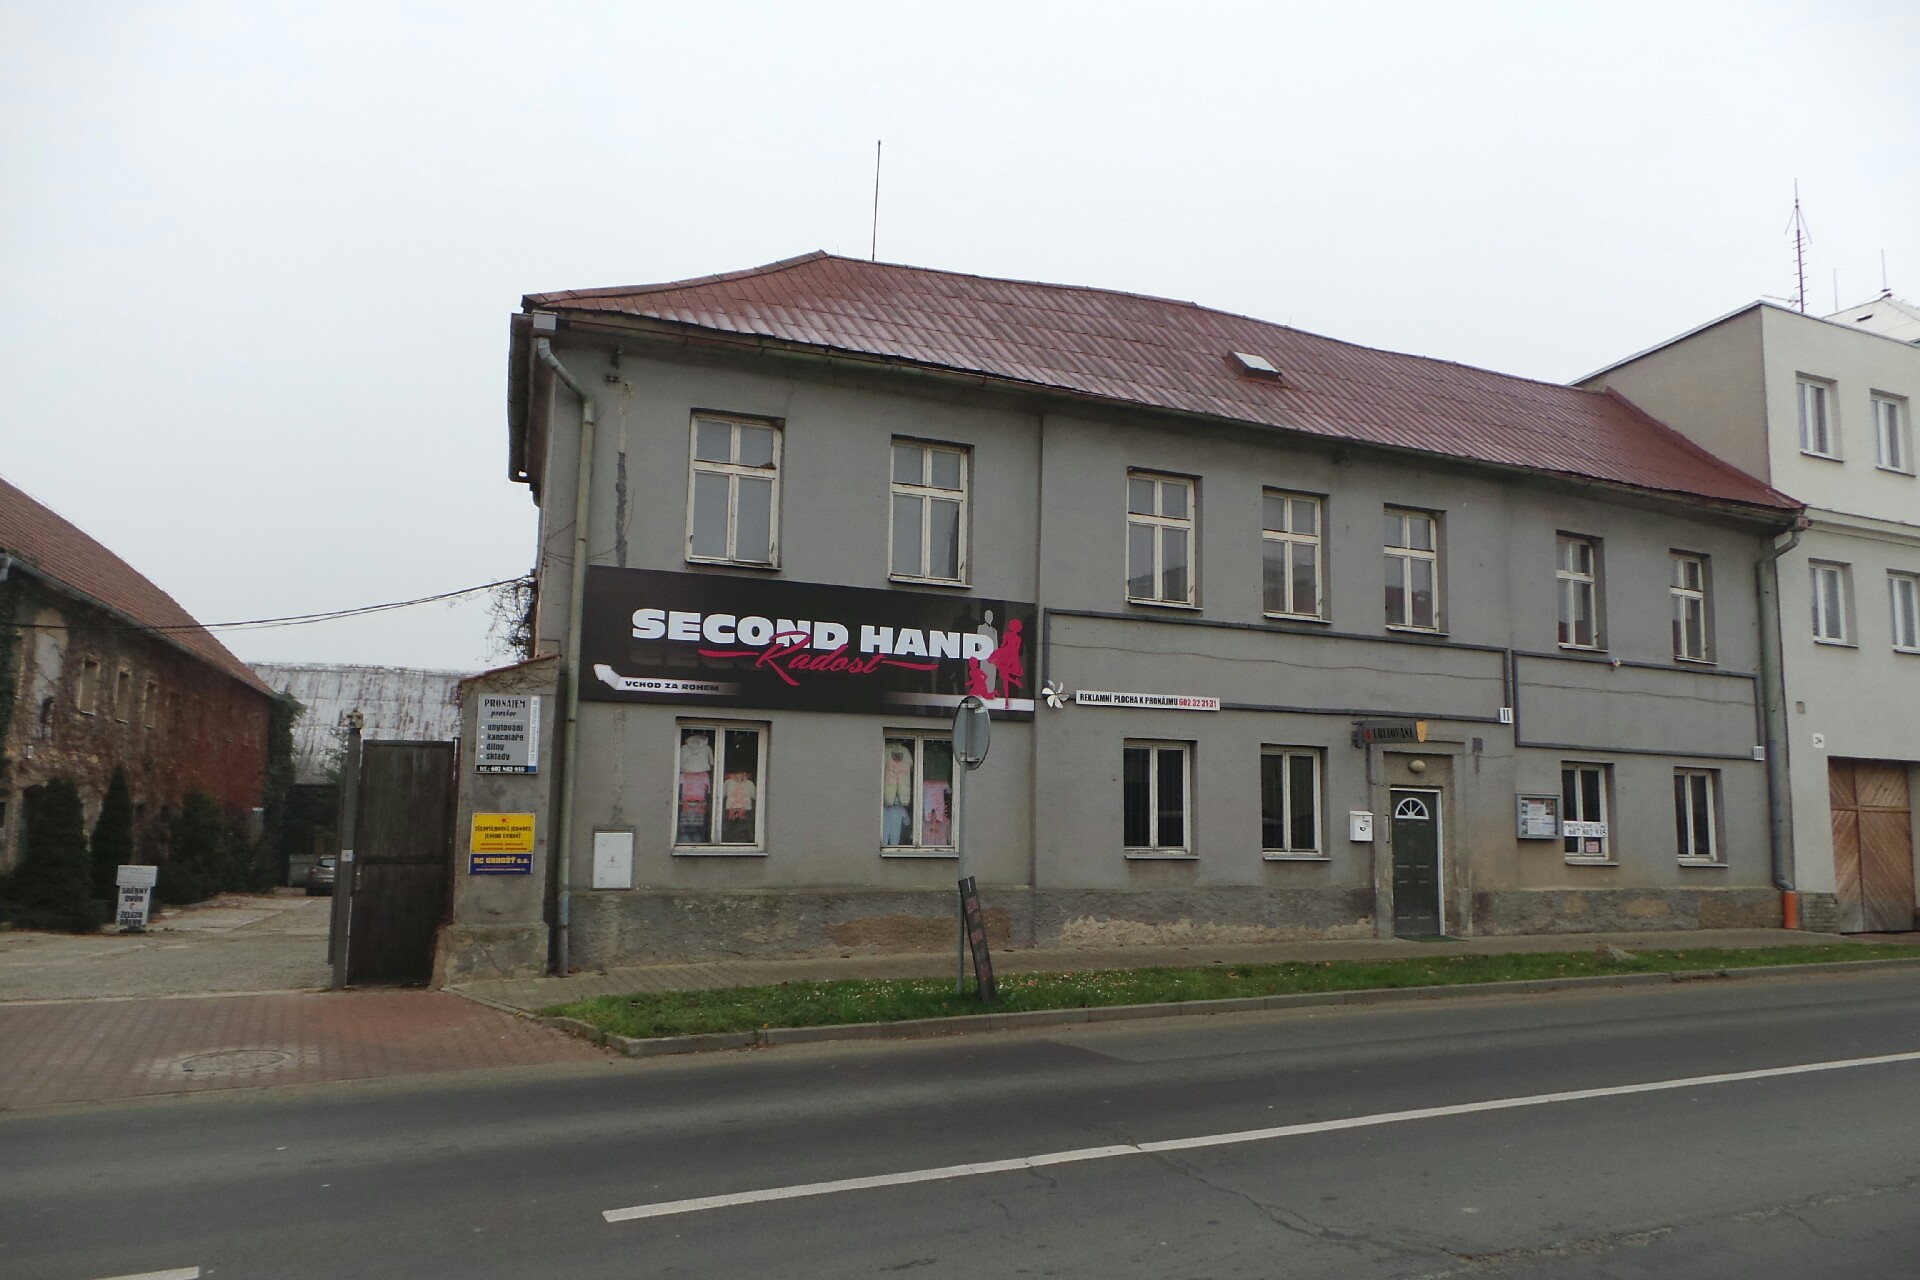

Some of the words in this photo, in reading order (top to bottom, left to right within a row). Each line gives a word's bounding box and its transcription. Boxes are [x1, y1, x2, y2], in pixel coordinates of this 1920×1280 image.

[632, 608, 849, 651] SECOND
[860, 624, 995, 661] HAND
[755, 630, 887, 687] Radost
[625, 680, 662, 689] VCHOD
[664, 682, 679, 690] ZA
[681, 683, 720, 692] ROHEM
[484, 697, 526, 709] PRONÁJEM
[1079, 693, 1113, 704] REKLAMNÍ
[1114, 694, 1139, 705] PLOCHA
[1139, 696, 1144, 705] K
[1145, 695, 1178, 706] PRONÁJMU
[1179, 697, 1192, 707] 602
[1192, 698, 1201, 708] 32
[490, 709, 517, 718] prostor
[487, 724, 524, 732] ubytování
[486, 733, 524, 742] kanceláře
[485, 752, 511, 761] sklady
[1568, 828, 1581, 836] 607
